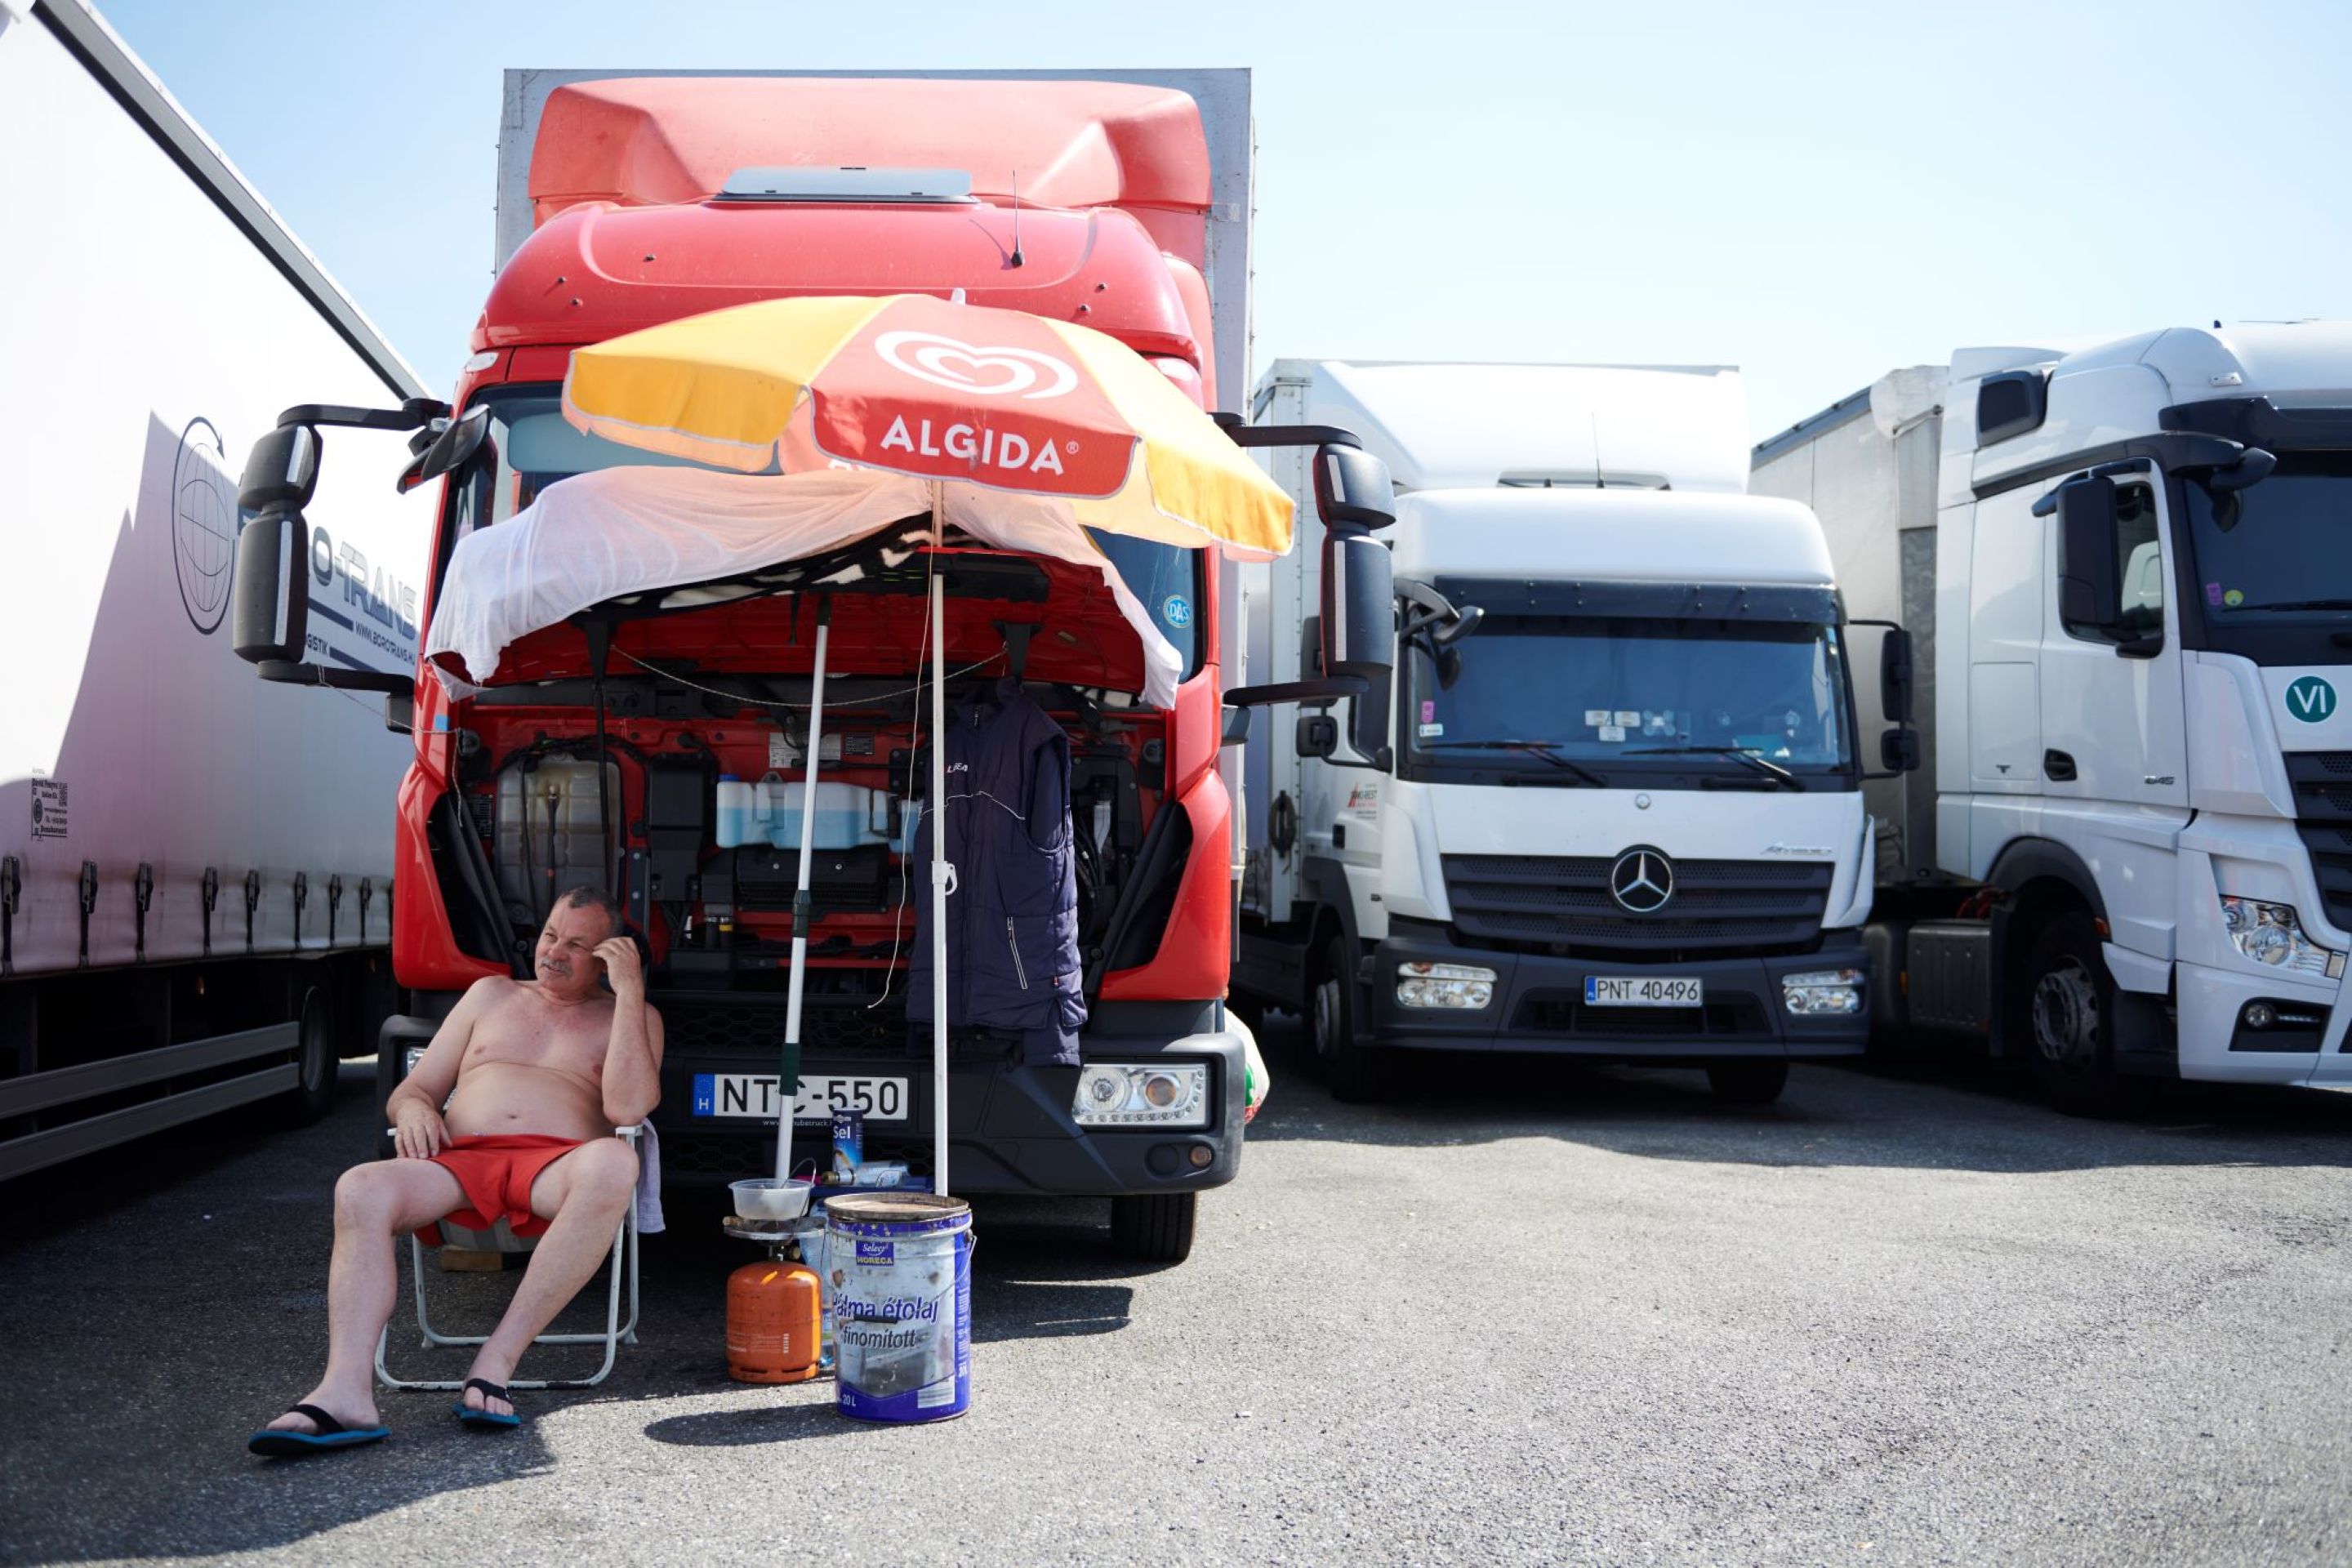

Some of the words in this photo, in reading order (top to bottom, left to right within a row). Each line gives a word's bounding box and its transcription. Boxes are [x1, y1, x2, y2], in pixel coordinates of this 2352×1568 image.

[2293, 685, 2326, 713] VI
[1597, 981, 1633, 1000] PNT
[1640, 981, 1698, 1000] 40496
[698, 1098, 709, 1111] H
[833, 1125, 851, 1139] Sel
[882, 1296, 939, 1324] étolaj
[843, 1326, 916, 1348] finomított
